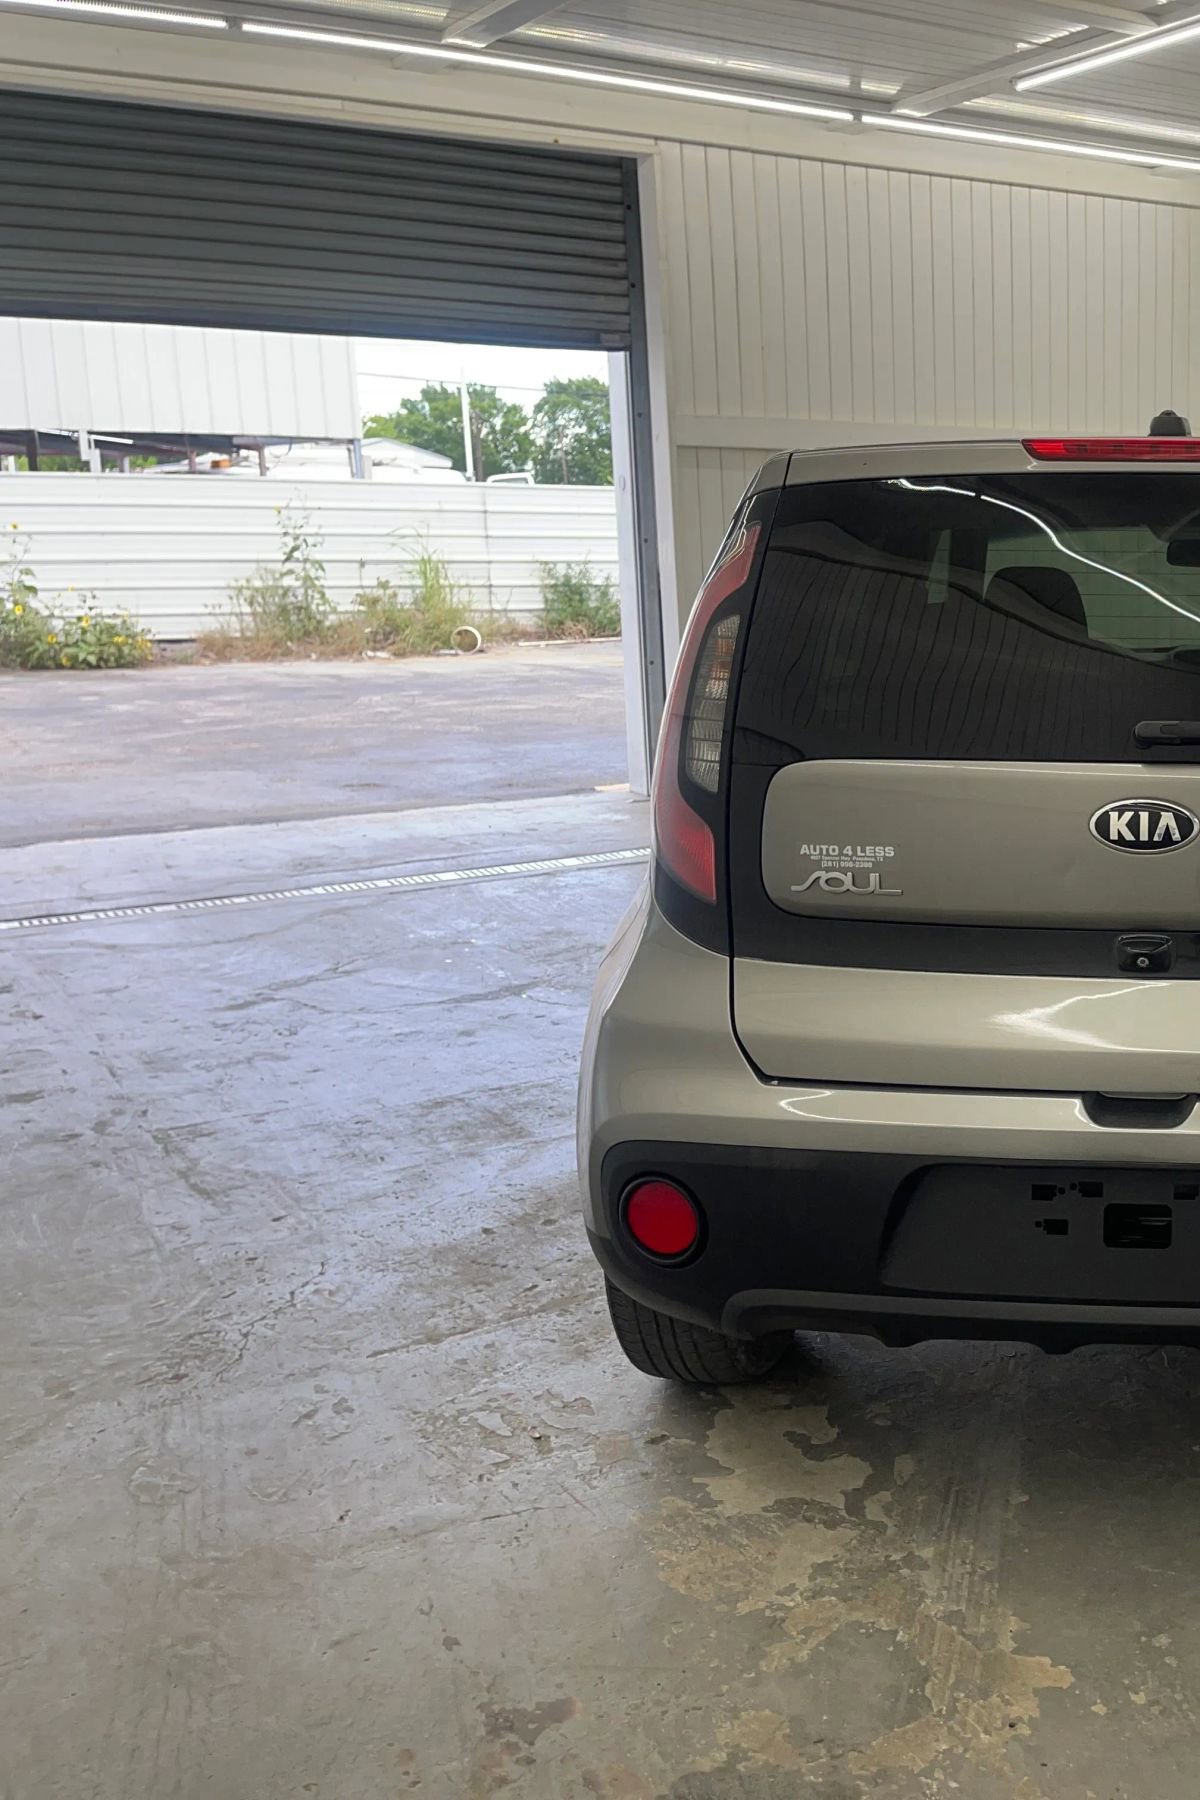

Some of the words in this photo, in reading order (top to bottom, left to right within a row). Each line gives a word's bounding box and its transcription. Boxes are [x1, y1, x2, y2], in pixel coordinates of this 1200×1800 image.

[1108, 811, 1182, 841] KIA
[800, 844, 839, 856] AUTO
[843, 845, 853, 857] 4
[857, 846, 895, 857] LESS
[790, 870, 904, 896] SOUL
